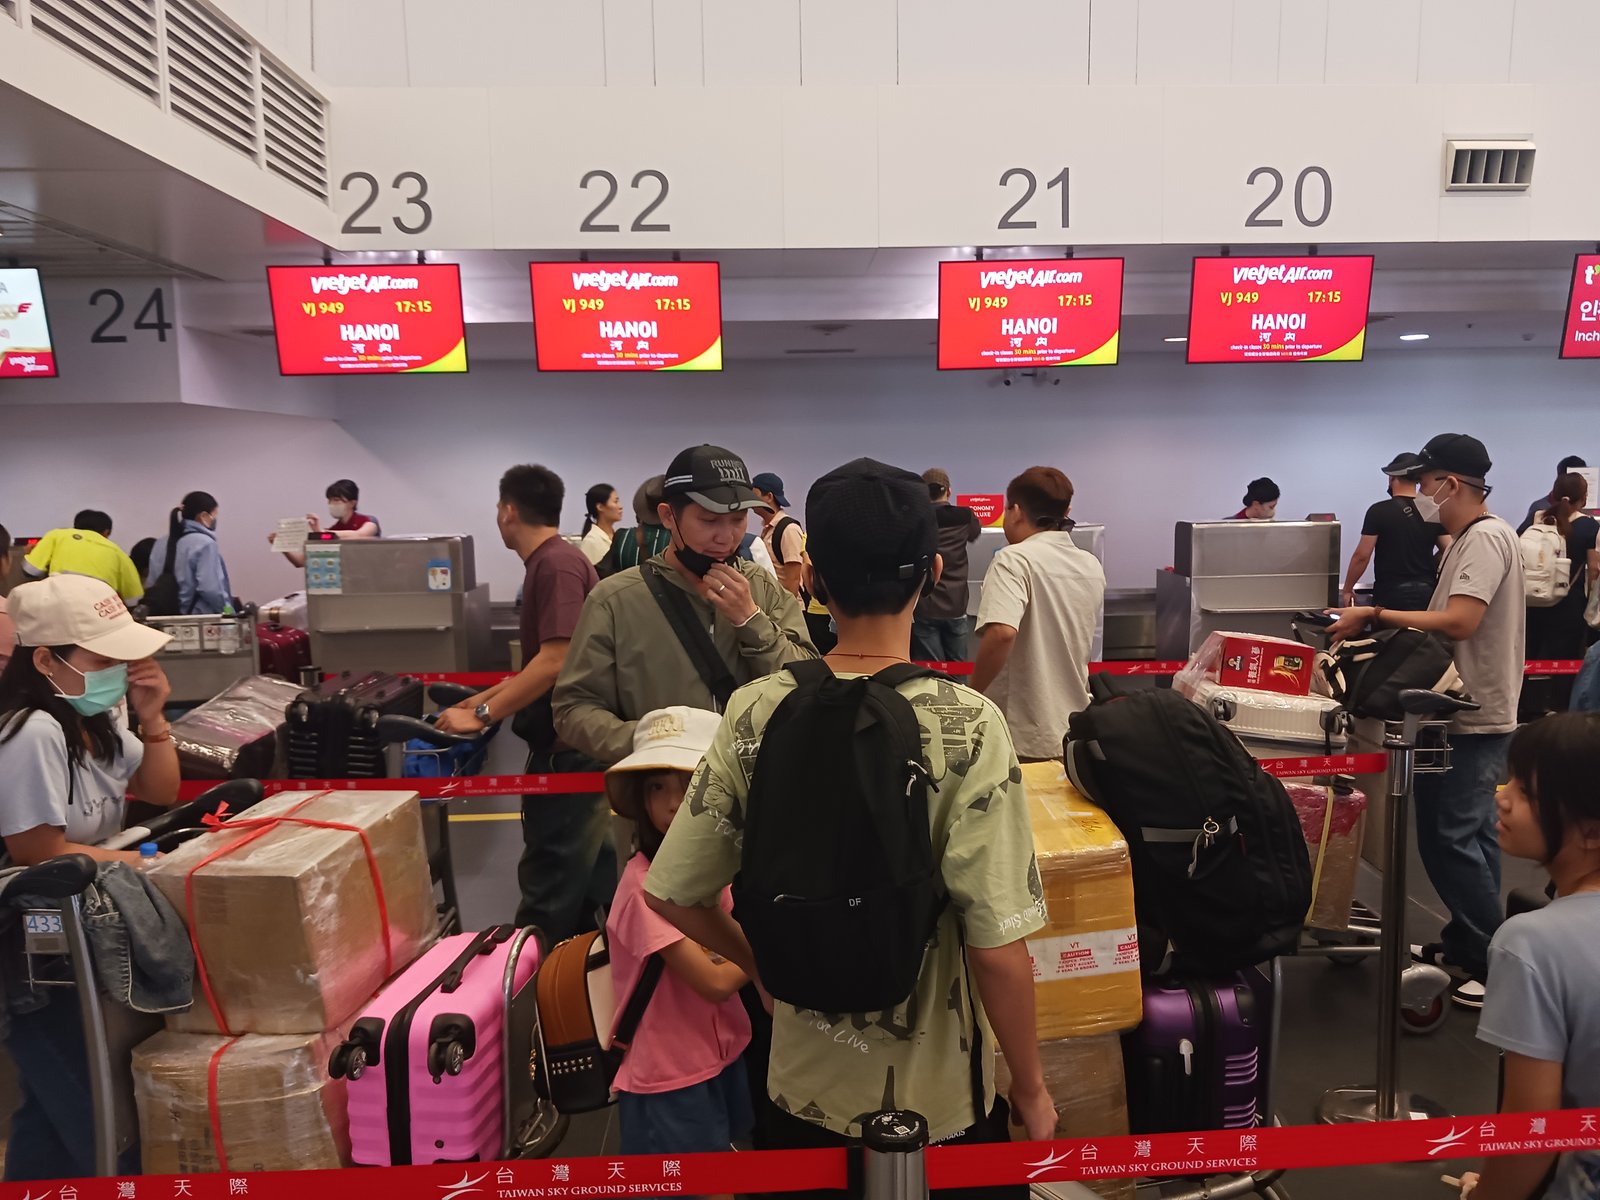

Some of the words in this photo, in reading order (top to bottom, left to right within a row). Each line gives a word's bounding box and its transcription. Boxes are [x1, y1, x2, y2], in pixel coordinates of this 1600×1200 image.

[340, 171, 432, 234] 23
[579, 169, 671, 232] 22
[997, 167, 1070, 229] 21
[1244, 166, 1332, 228] 20
[655, 298, 691, 311] 17:15
[968, 297, 981, 312] VJ
[984, 296, 1008, 309] 949
[1058, 294, 1092, 307] 17:15
[1219, 292, 1232, 306] VJ
[1236, 291, 1259, 304] 949
[1307, 291, 1341, 303] 17:15
[302, 302, 317, 317] VJ
[319, 301, 344, 314] 949
[395, 300, 432, 313] 17:15
[562, 298, 577, 313] VJ
[579, 298, 604, 311] 949
[88, 288, 172, 343] 24
[1251, 313, 1307, 330] HANOI
[340, 323, 400, 341] HANOI
[599, 320, 658, 338] HANOI
[1001, 317, 1058, 335] HANOI
[848, 897, 861, 907] DF
[27, 916, 61, 932] 433
[1069, 941, 1080, 949] VT
[1062, 950, 1091, 958] CAUTION
[1080, 1135, 1257, 1161] 台灣天際
[1479, 1141, 1521, 1152] TAIWAN
[1523, 1140, 1543, 1150] SKY
[1544, 1137, 1596, 1149] GROUND
[495, 1160, 681, 1184] 台灣天際
[1080, 1165, 1126, 1175] TAIWAN
[1128, 1163, 1149, 1173] SKY
[1150, 1160, 1204, 1172] GROUND
[1205, 1157, 1257, 1168] SERVICES
[496, 1188, 545, 1199] TAIWAN
[547, 1187, 570, 1197] SKY
[570, 1184, 626, 1195] GROUND
[628, 1182, 682, 1193] SERVICES
